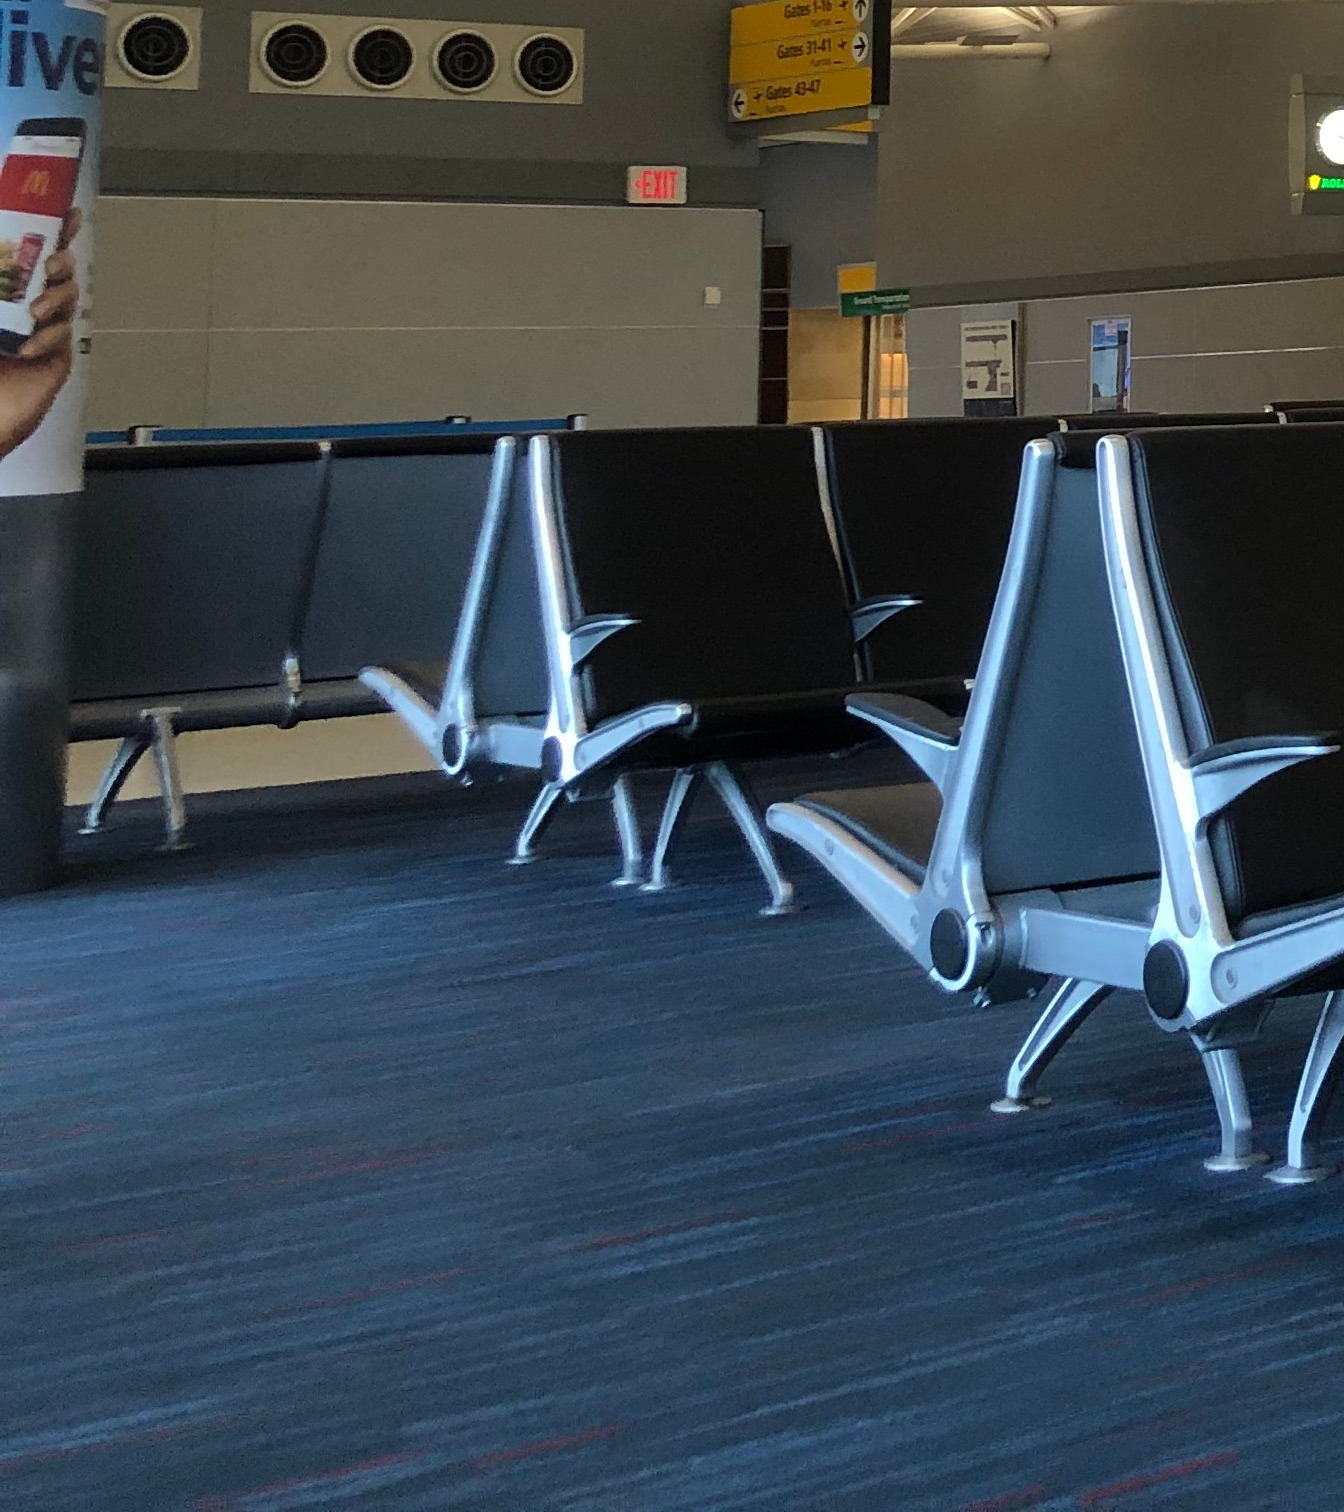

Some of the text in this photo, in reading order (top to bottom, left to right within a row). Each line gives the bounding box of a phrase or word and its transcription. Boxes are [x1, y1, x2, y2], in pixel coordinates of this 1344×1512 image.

[784, 4, 811, 18] Gates
[777, 38, 832, 59] Gates 31-41
[766, 79, 820, 100] Gates 43-47
[642, 171, 678, 199] EXIT
